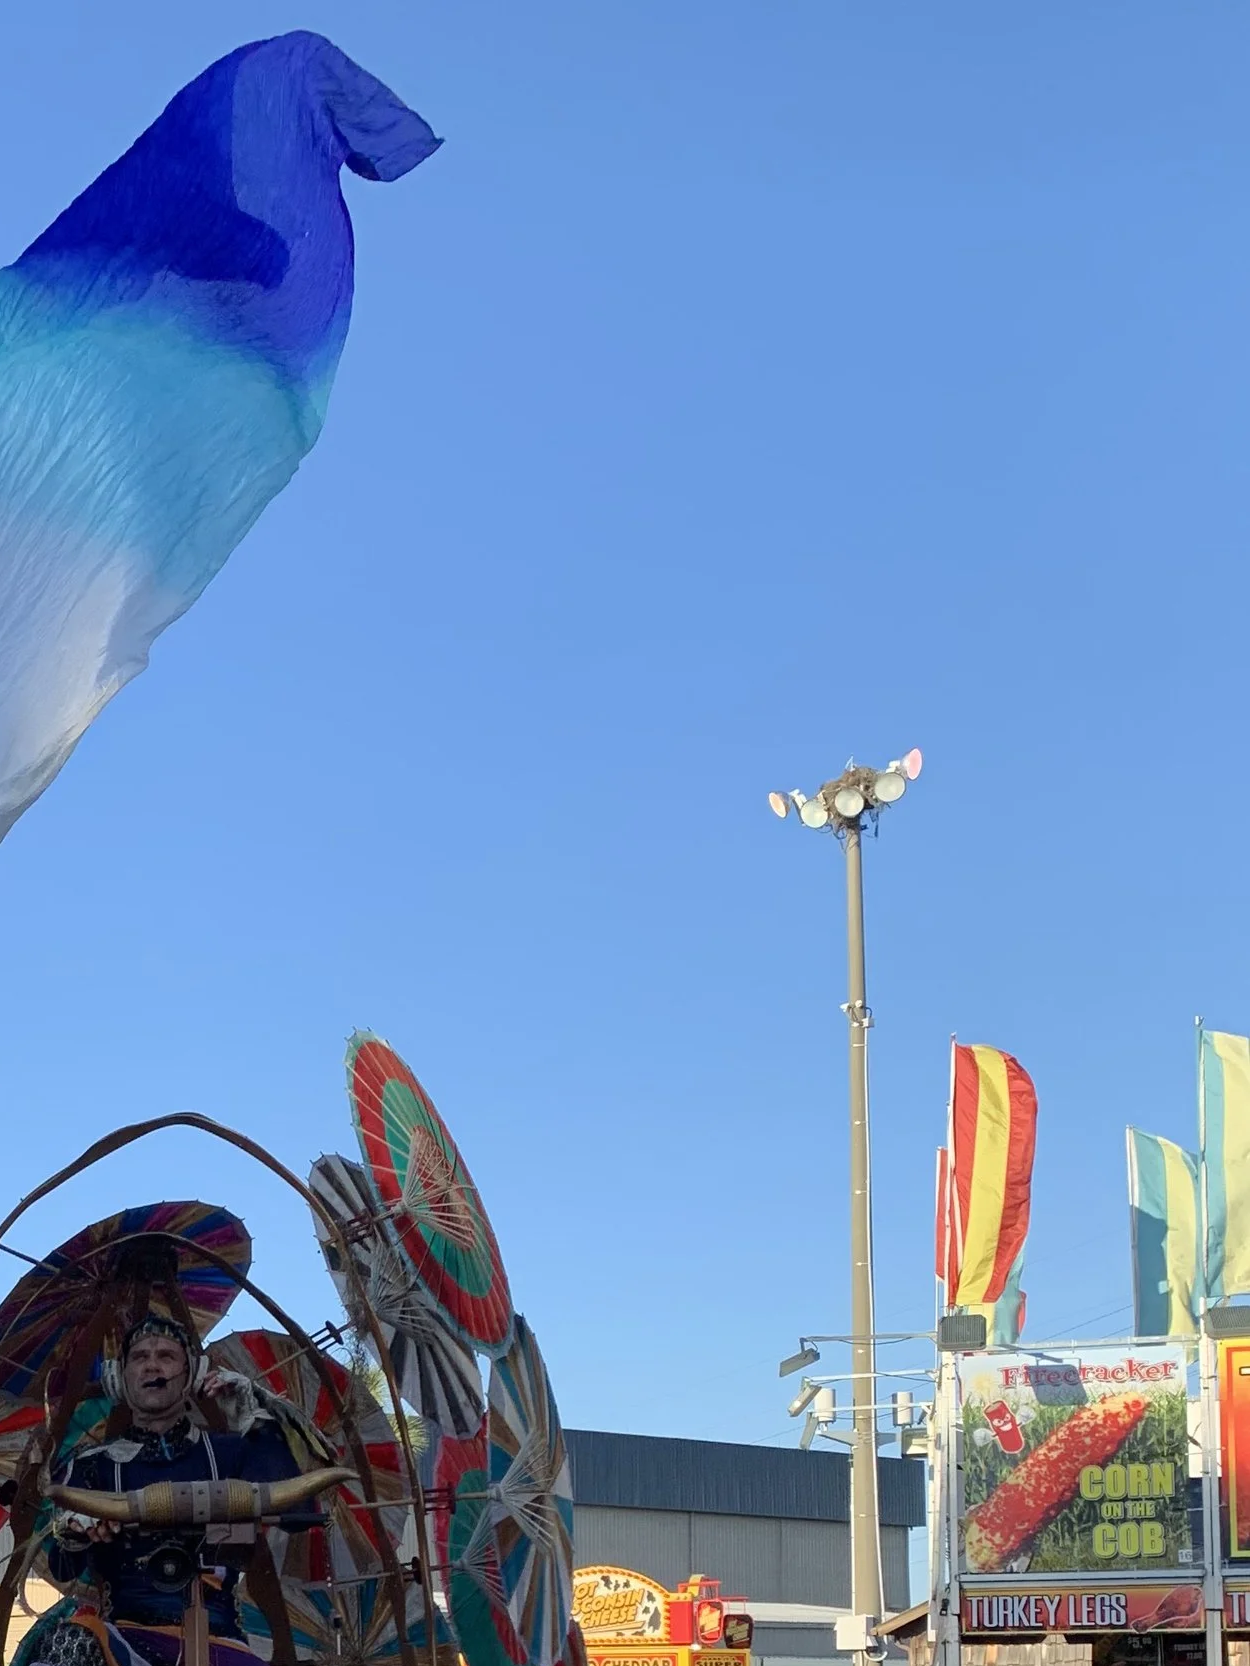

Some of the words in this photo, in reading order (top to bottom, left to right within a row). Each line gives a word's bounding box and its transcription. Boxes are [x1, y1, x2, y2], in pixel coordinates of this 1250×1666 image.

[1000, 1358, 1178, 1388] Firecracker
[1079, 1462, 1176, 1500] CORN
[1101, 1501, 1124, 1519] ON
[1125, 1500, 1156, 1519] THE
[1092, 1521, 1167, 1559] COB
[572, 1588, 645, 1616] SCONSIN
[966, 1595, 1062, 1629] TURKEY
[1067, 1593, 1128, 1627] LEGS
[580, 1605, 638, 1630] CHEESE
